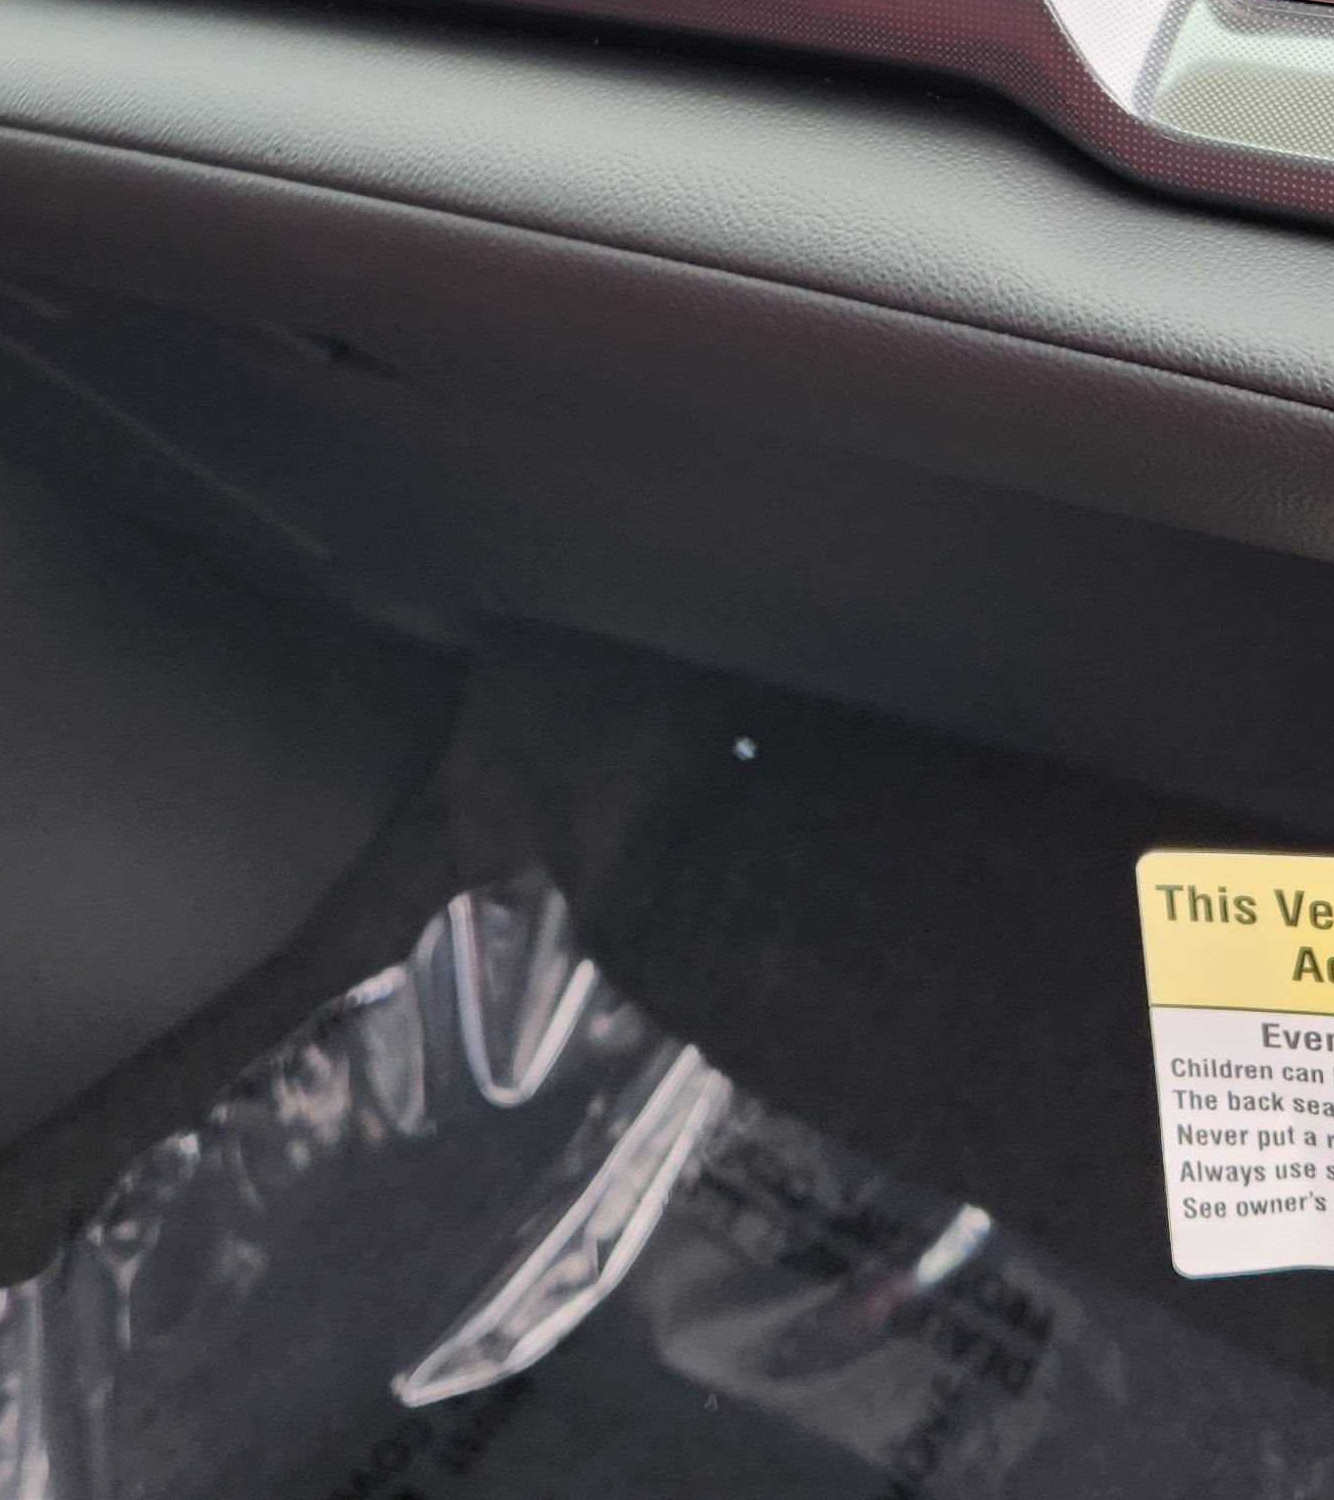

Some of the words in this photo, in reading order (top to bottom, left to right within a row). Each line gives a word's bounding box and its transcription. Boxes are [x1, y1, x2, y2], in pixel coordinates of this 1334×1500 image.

[1155, 884, 1258, 926] This
[1170, 1057, 1273, 1080] Children
[1281, 1066, 1325, 1085] can
[1173, 1089, 1218, 1111] The
[1226, 1090, 1285, 1112] back
[1177, 1123, 1249, 1146] Never
[1257, 1125, 1295, 1152] put
[1303, 1130, 1317, 1147] a
[1180, 1160, 1267, 1187] Always
[1274, 1162, 1317, 1180] use
[1183, 1196, 1227, 1219] See
[1235, 1190, 1327, 1217] owner's
